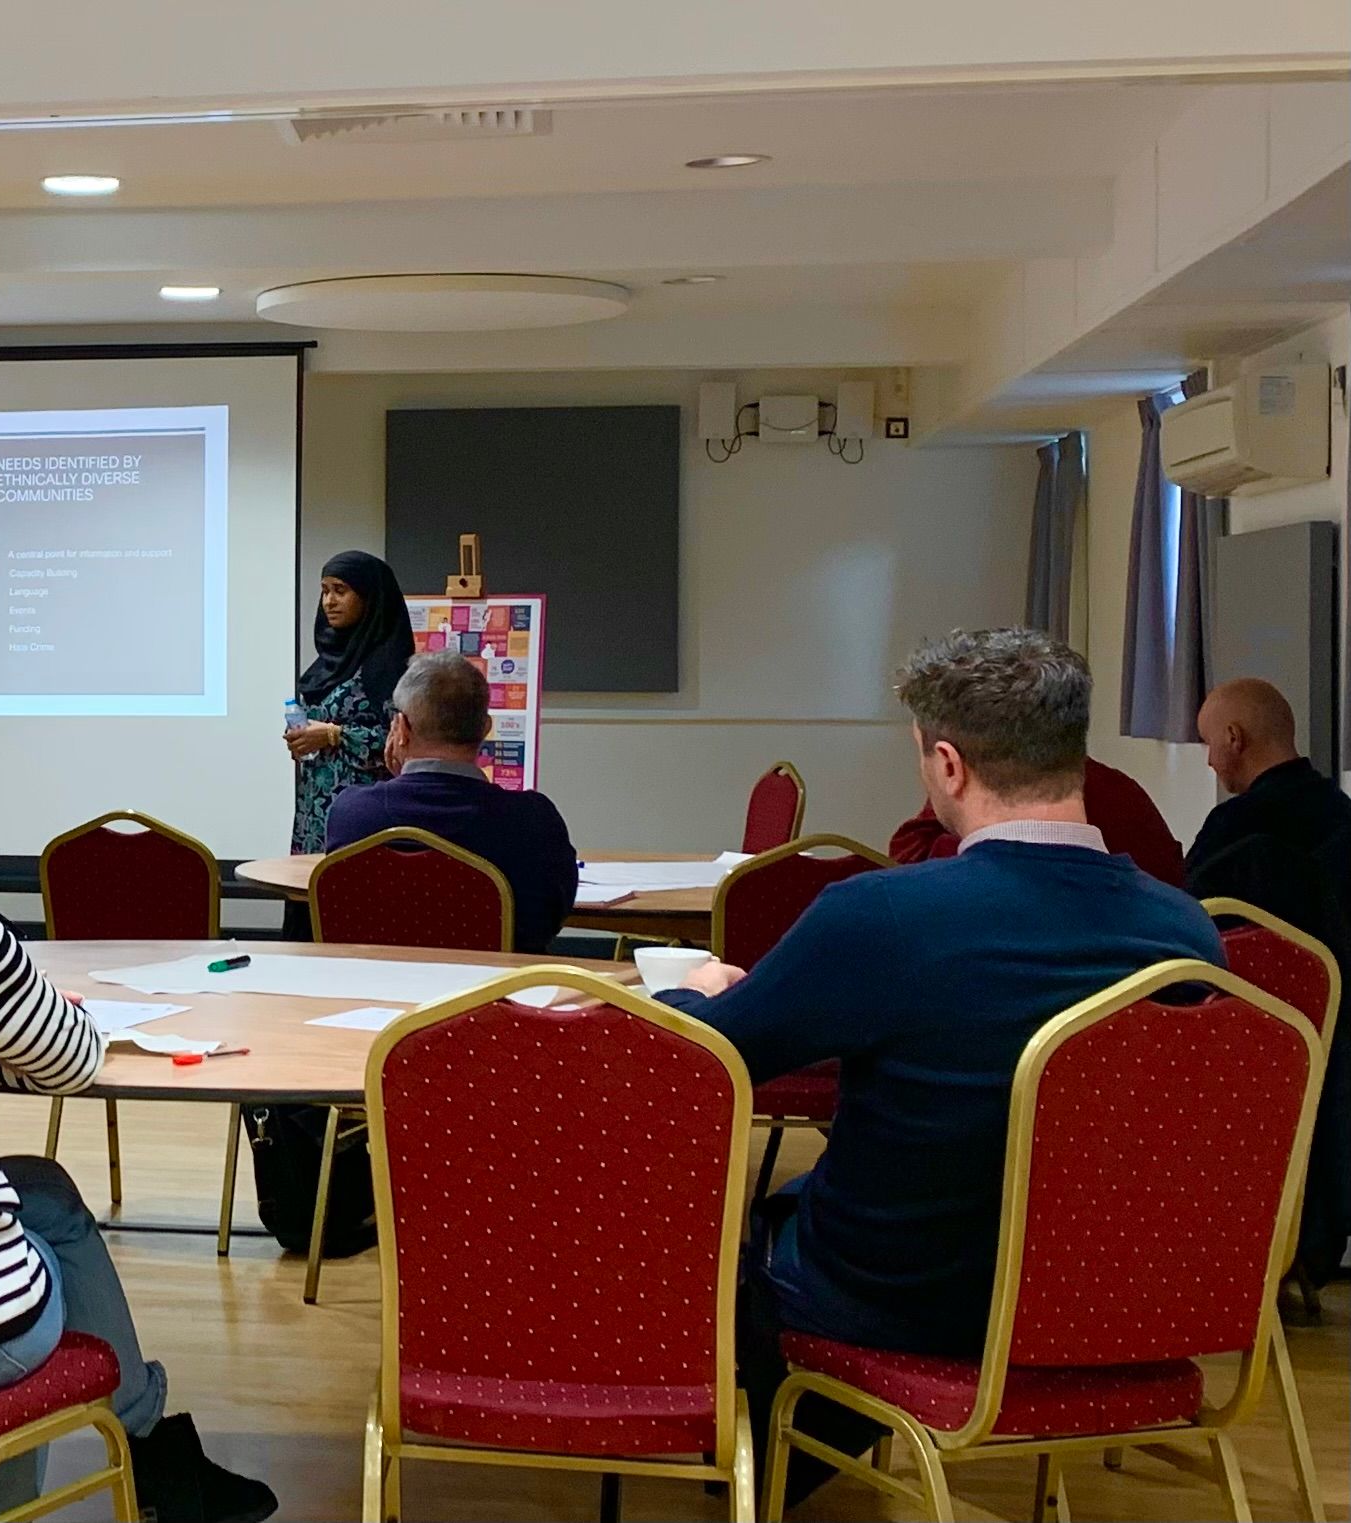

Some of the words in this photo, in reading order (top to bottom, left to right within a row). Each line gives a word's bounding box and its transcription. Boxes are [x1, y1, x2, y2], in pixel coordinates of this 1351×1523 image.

[45, 456, 120, 470] IDENTIFIED
[123, 455, 142, 468] BY
[82, 471, 140, 485] DIVERSE
[8, 550, 15, 559] A
[16, 550, 43, 559] central
[45, 549, 65, 560] point
[9, 587, 49, 598] Language
[9, 606, 37, 615] Events
[9, 625, 41, 635] Funding
